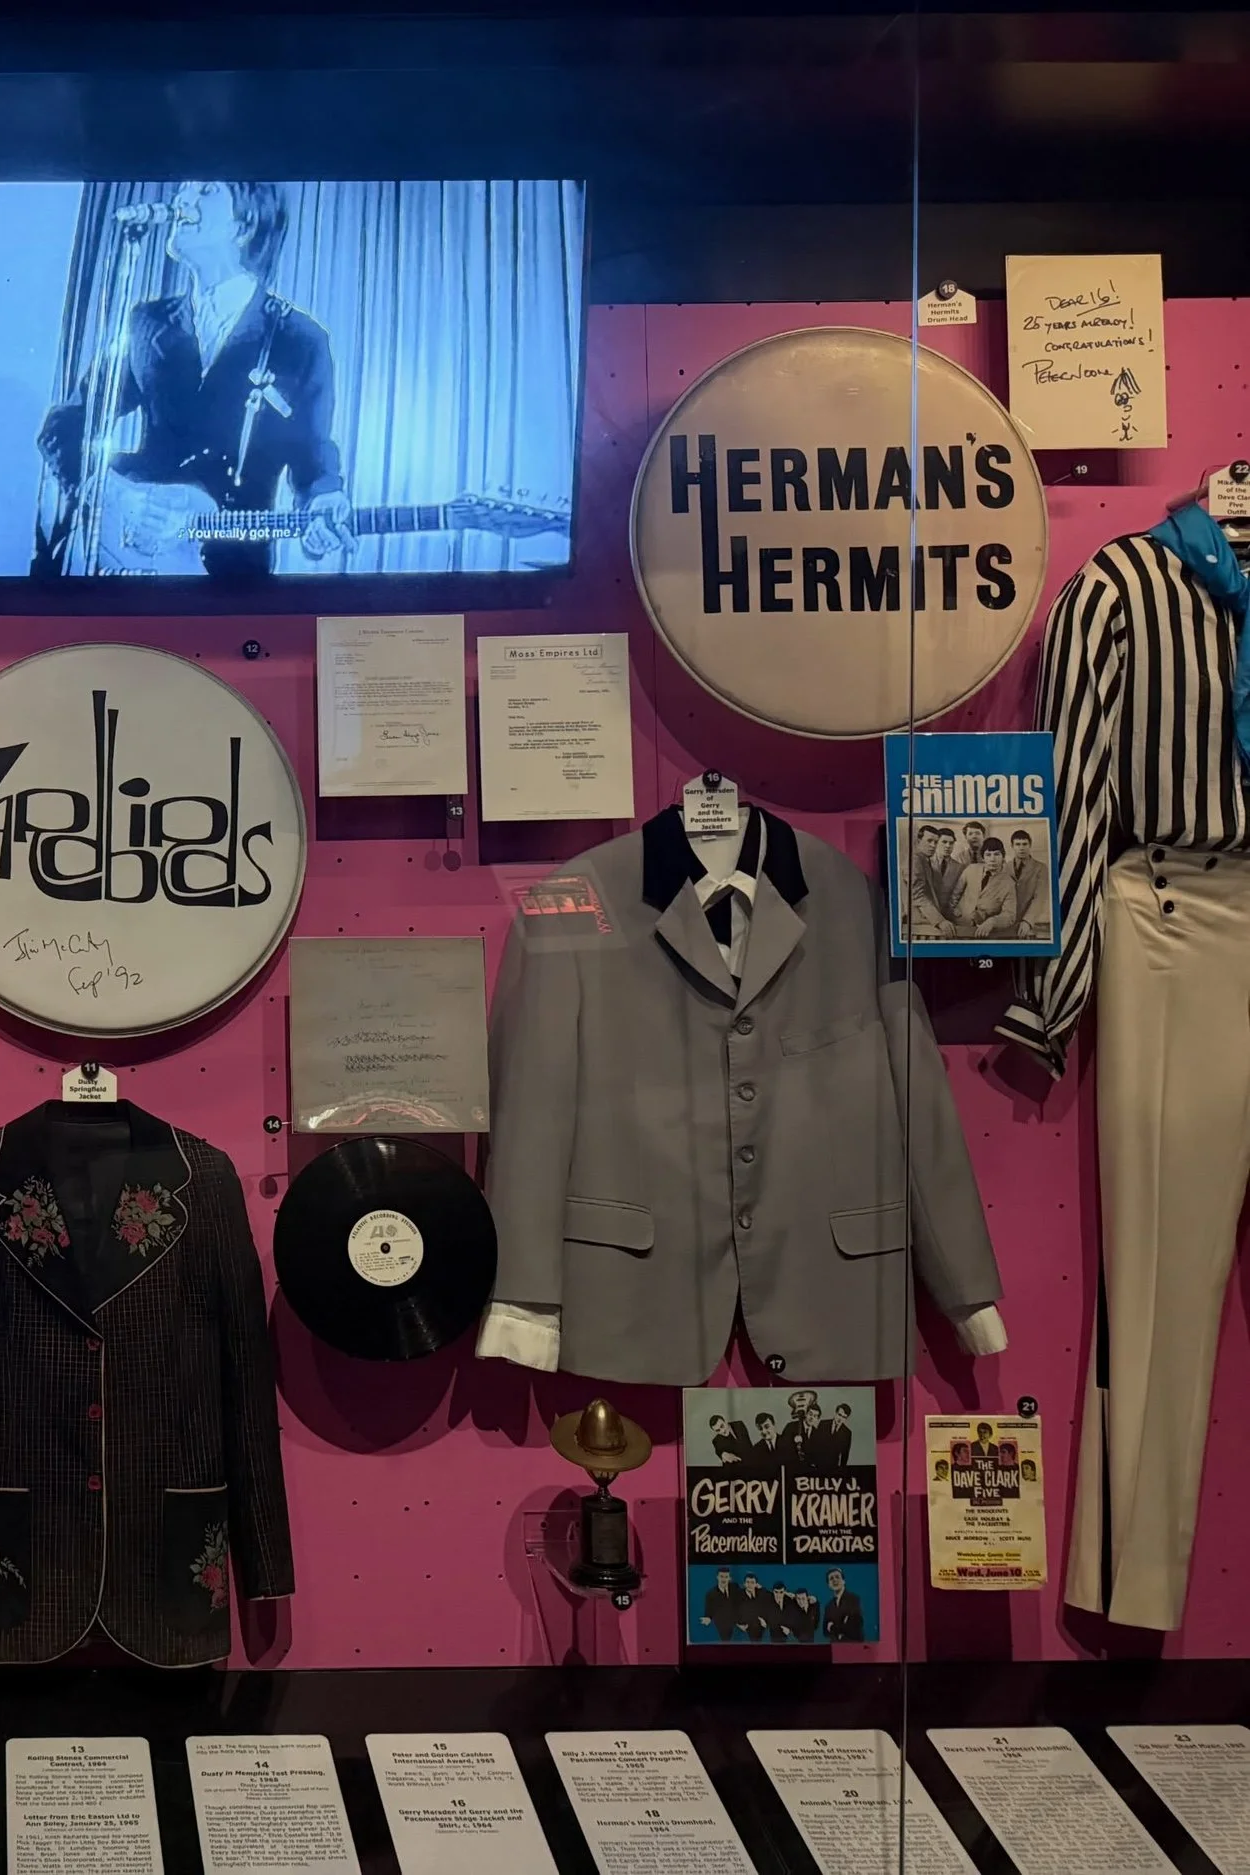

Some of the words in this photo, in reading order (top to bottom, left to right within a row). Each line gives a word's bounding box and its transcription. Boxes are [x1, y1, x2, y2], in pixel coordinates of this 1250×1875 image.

[942, 284, 955, 292] 18
[1023, 316, 1043, 330] 25
[1044, 320, 1077, 334] YEARS
[669, 432, 1016, 514] HERMAN'S
[1075, 465, 1088, 474] 19
[1235, 464, 1249, 474] 22
[188, 528, 210, 538] You
[214, 528, 248, 540] really
[250, 528, 270, 540] got
[272, 530, 291, 538] me
[703, 533, 1016, 613] HERMITS
[245, 644, 258, 653] 12
[508, 648, 536, 658] Moss
[539, 648, 578, 660] Empires
[582, 647, 598, 658] Ltd
[706, 773, 720, 782] 16
[901, 774, 942, 787] THE
[450, 807, 463, 815] 13
[978, 959, 993, 968] 20
[84, 1063, 97, 1072] 11
[266, 1120, 280, 1129] 14
[770, 1360, 782, 1369] 17
[1022, 1402, 1035, 1411] 21
[976, 1460, 994, 1470] THE
[795, 1476, 842, 1492] BILLY
[846, 1476, 860, 1491] J.
[953, 1470, 981, 1489] DAVE
[984, 1470, 1019, 1489] CLARK
[691, 1478, 780, 1518] GERRY
[974, 1488, 1001, 1498] FIVE
[791, 1492, 877, 1528] KRAMER
[690, 1523, 778, 1554] Pacemakers
[793, 1535, 876, 1554] DAKOTAS
[986, 1567, 1010, 1577] June
[1010, 1567, 1022, 1577] 10
[615, 1595, 630, 1605] 15
[842, 1790, 859, 1798] 20
[645, 1810, 660, 1818] 18
